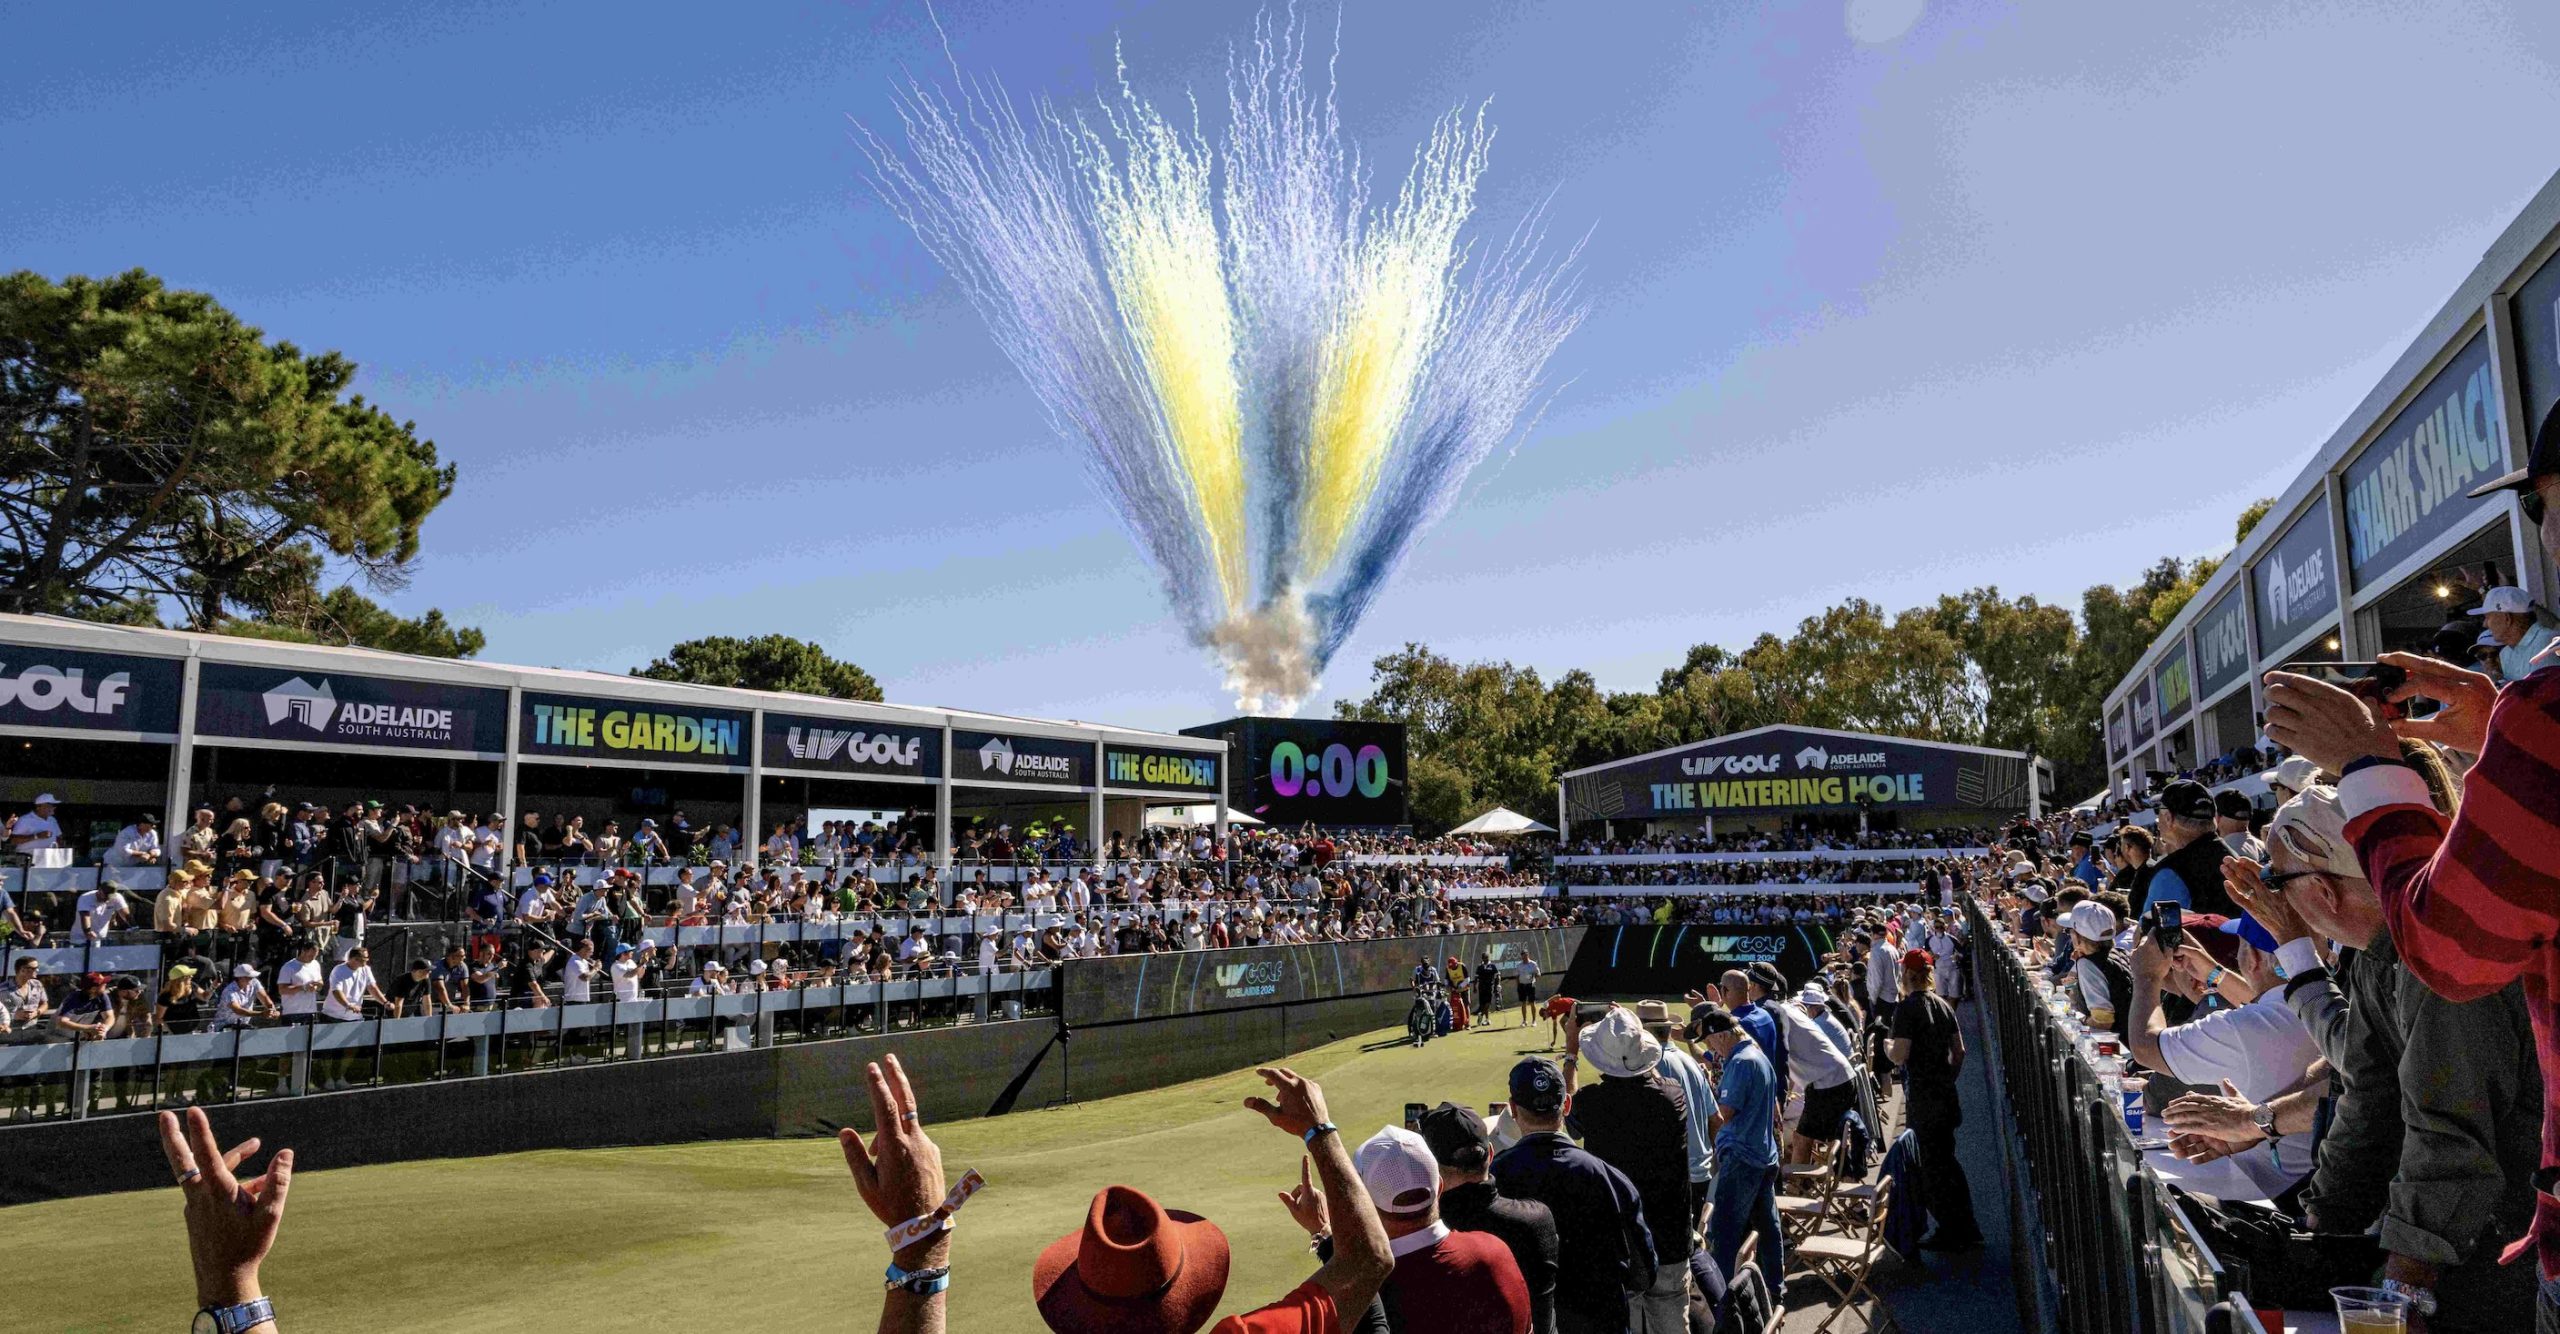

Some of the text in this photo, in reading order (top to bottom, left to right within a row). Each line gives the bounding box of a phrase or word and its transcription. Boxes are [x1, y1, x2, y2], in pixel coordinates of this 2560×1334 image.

[2346, 437, 2418, 570] SHARK
[2287, 548, 2325, 606] ADELAIDE
[339, 702, 453, 730] ADELAIDE
[338, 724, 451, 741] SOUTH AUSTRALIA
[534, 704, 740, 756] THE GARDEN
[787, 727, 921, 766] LIV GOLF
[1830, 752, 1886, 765] ADELAIDE
[1014, 768, 1070, 779] SOUTH AUSTRALIA
[1015, 754, 1070, 772] ADELAIDE
[1107, 752, 1215, 787] THE GARDEN
[1270, 741, 1388, 799] 0:00
[1681, 754, 1781, 776] LIV GOLF
[1650, 773, 1925, 810] THE WATERING HOLE
[1700, 935, 1786, 953] LIV GOLF
[1712, 953, 1776, 962] ADELAIDE 2024
[1215, 961, 1282, 987] LIV GOLF
[1225, 984, 1275, 998] ADELAIDE 2024
